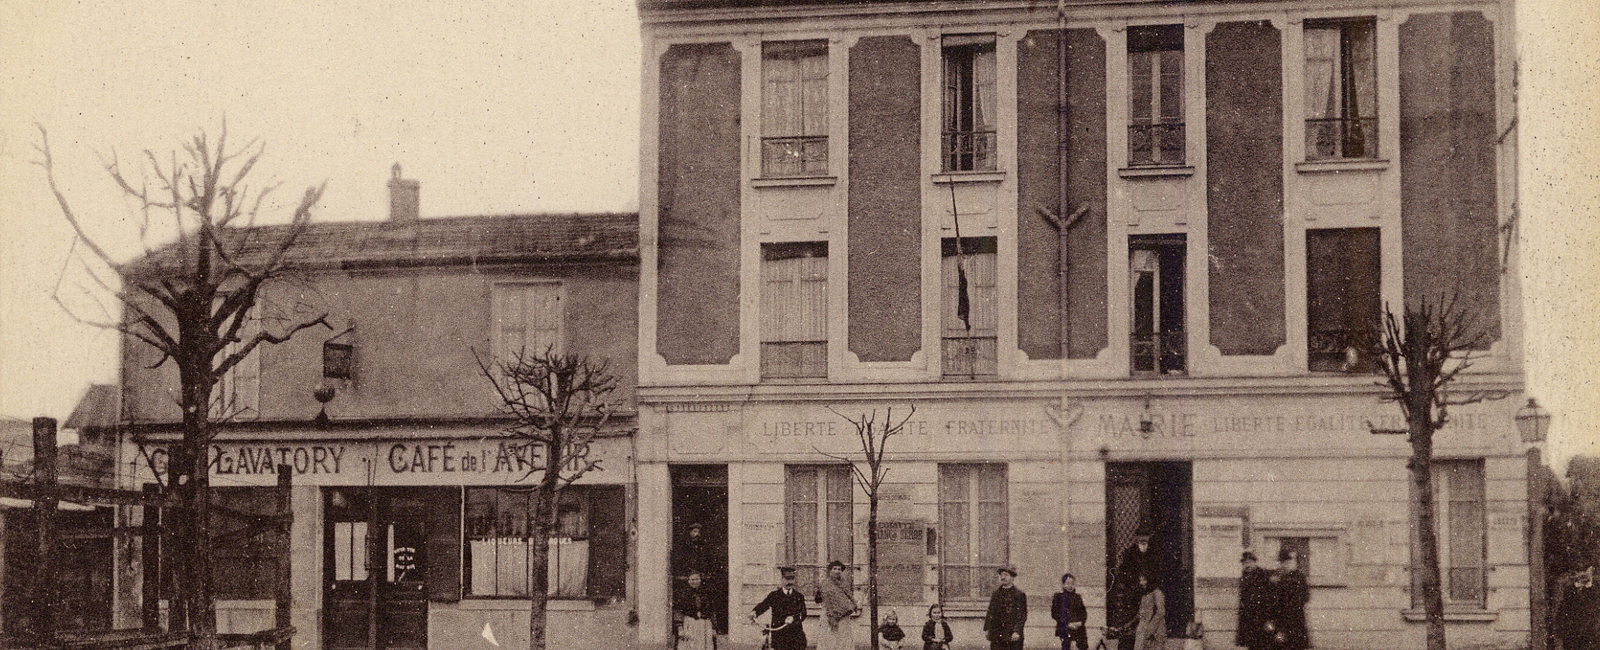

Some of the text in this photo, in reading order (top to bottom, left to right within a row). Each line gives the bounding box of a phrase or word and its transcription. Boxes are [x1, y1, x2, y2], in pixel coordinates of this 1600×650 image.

[763, 421, 837, 437] LIBERTE
[214, 446, 345, 475] LAVATORY
[388, 442, 456, 474] CAFÉ
[461, 450, 477, 472] de
